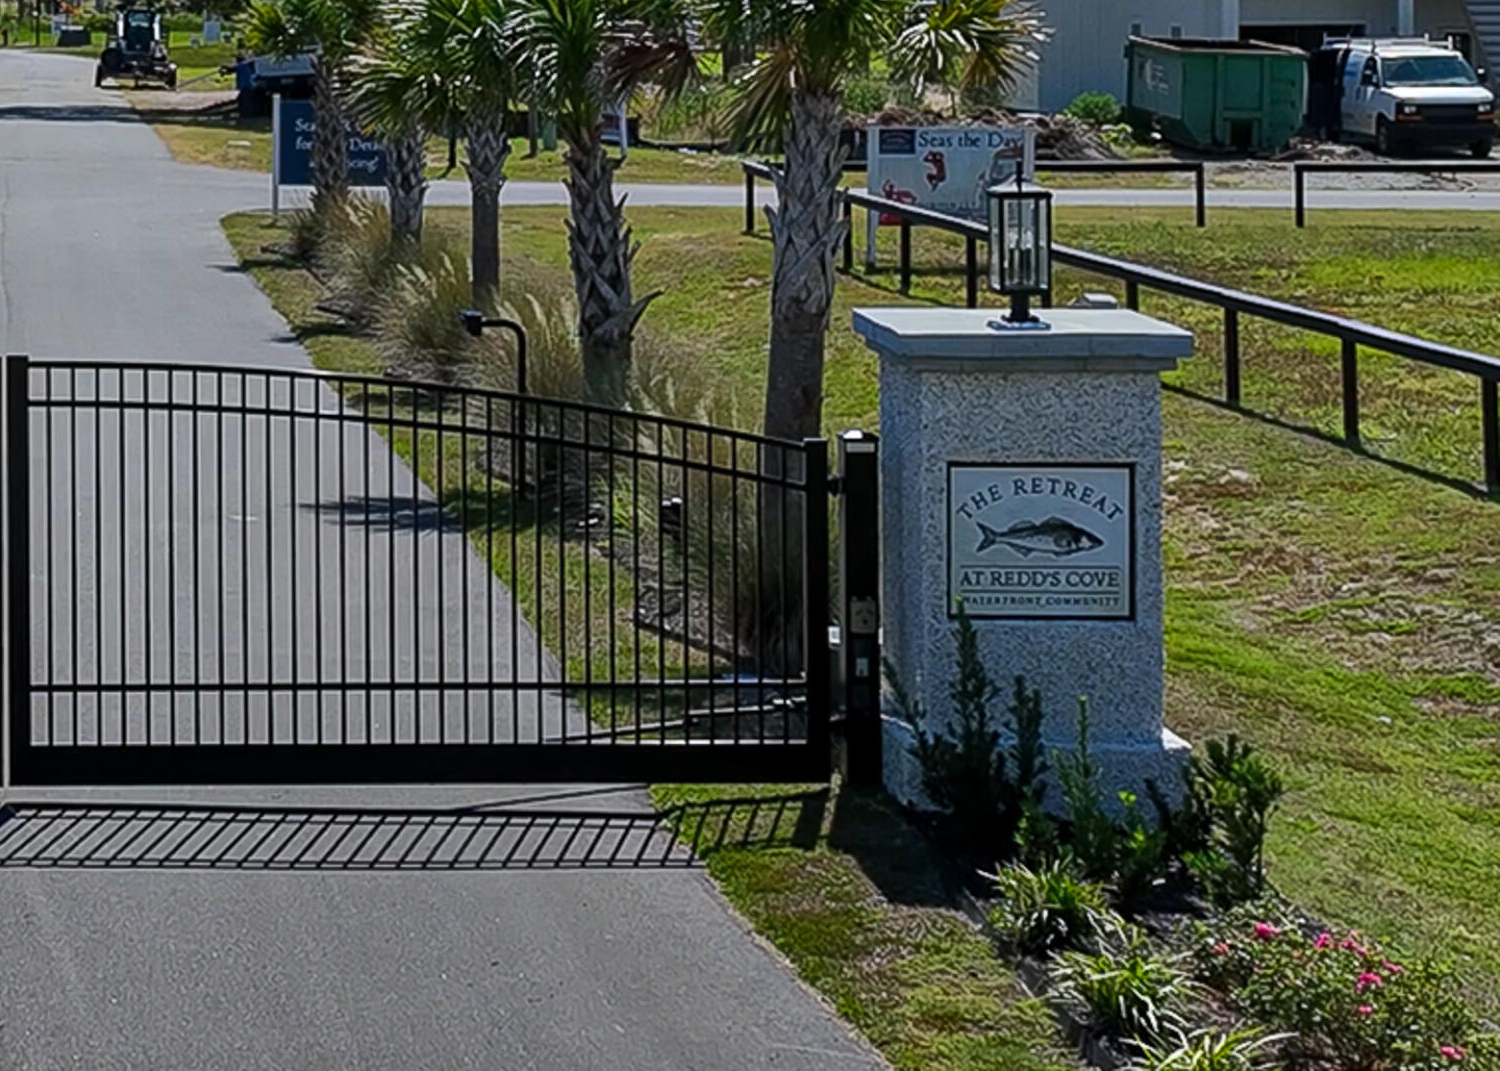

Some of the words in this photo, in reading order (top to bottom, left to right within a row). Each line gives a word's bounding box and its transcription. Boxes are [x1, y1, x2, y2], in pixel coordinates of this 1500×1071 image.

[918, 131, 954, 148] Seas
[958, 131, 981, 148] the
[956, 483, 1003, 520] THE
[1012, 478, 1124, 520] RETREAT
[960, 571, 985, 586] AT
[990, 571, 1060, 587] REDD'S
[1065, 571, 1120, 588] COVE
[1045, 596, 1120, 606] COMMUNITY
